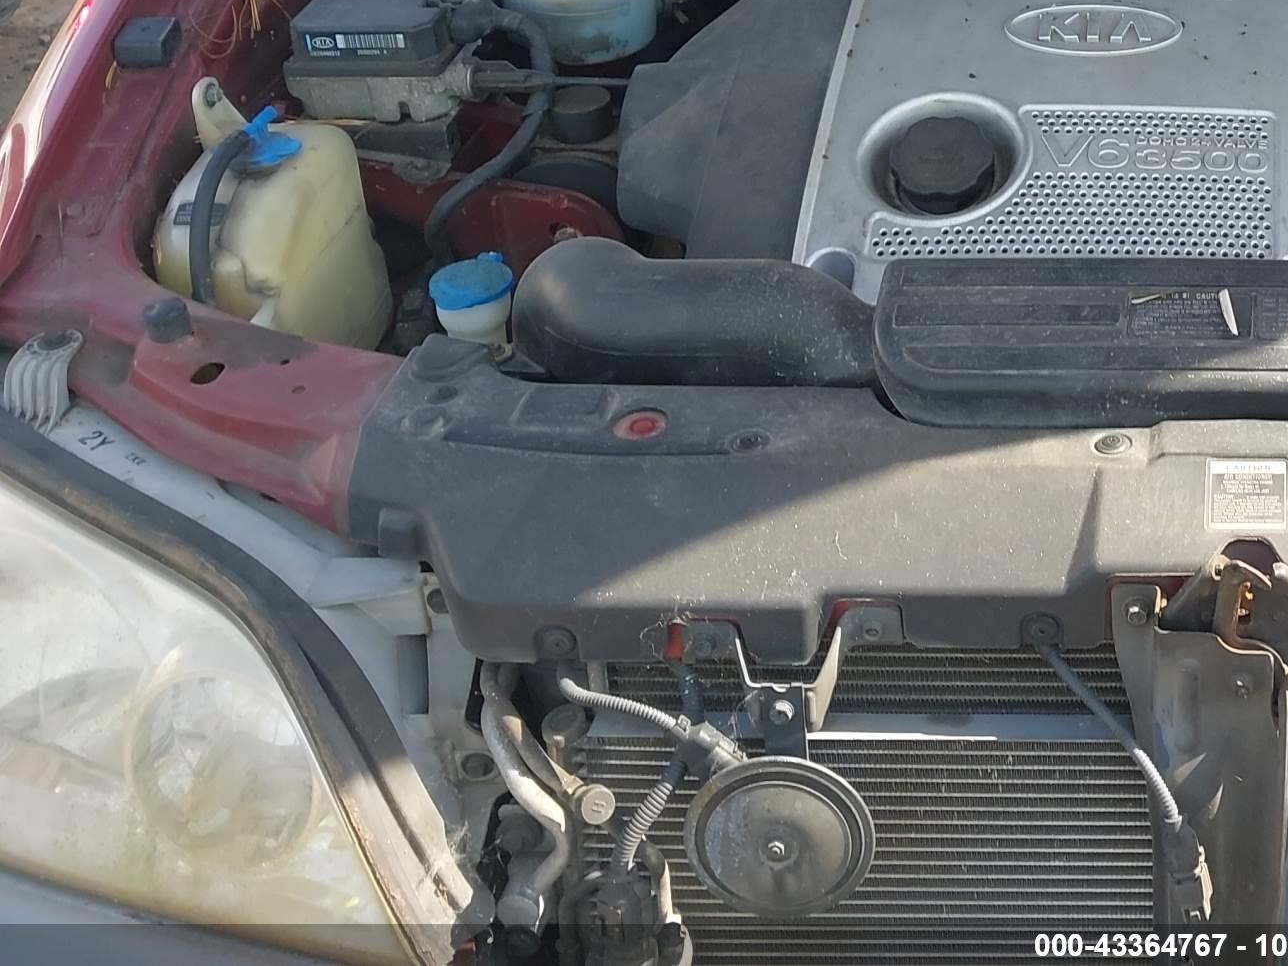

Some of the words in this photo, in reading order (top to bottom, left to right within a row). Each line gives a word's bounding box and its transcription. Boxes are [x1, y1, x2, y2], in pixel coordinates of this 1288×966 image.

[1037, 11, 1152, 43] KIA
[1041, 134, 1130, 169] V6
[1134, 147, 1268, 173] 3500
[1213, 137, 1268, 150] VALVE
